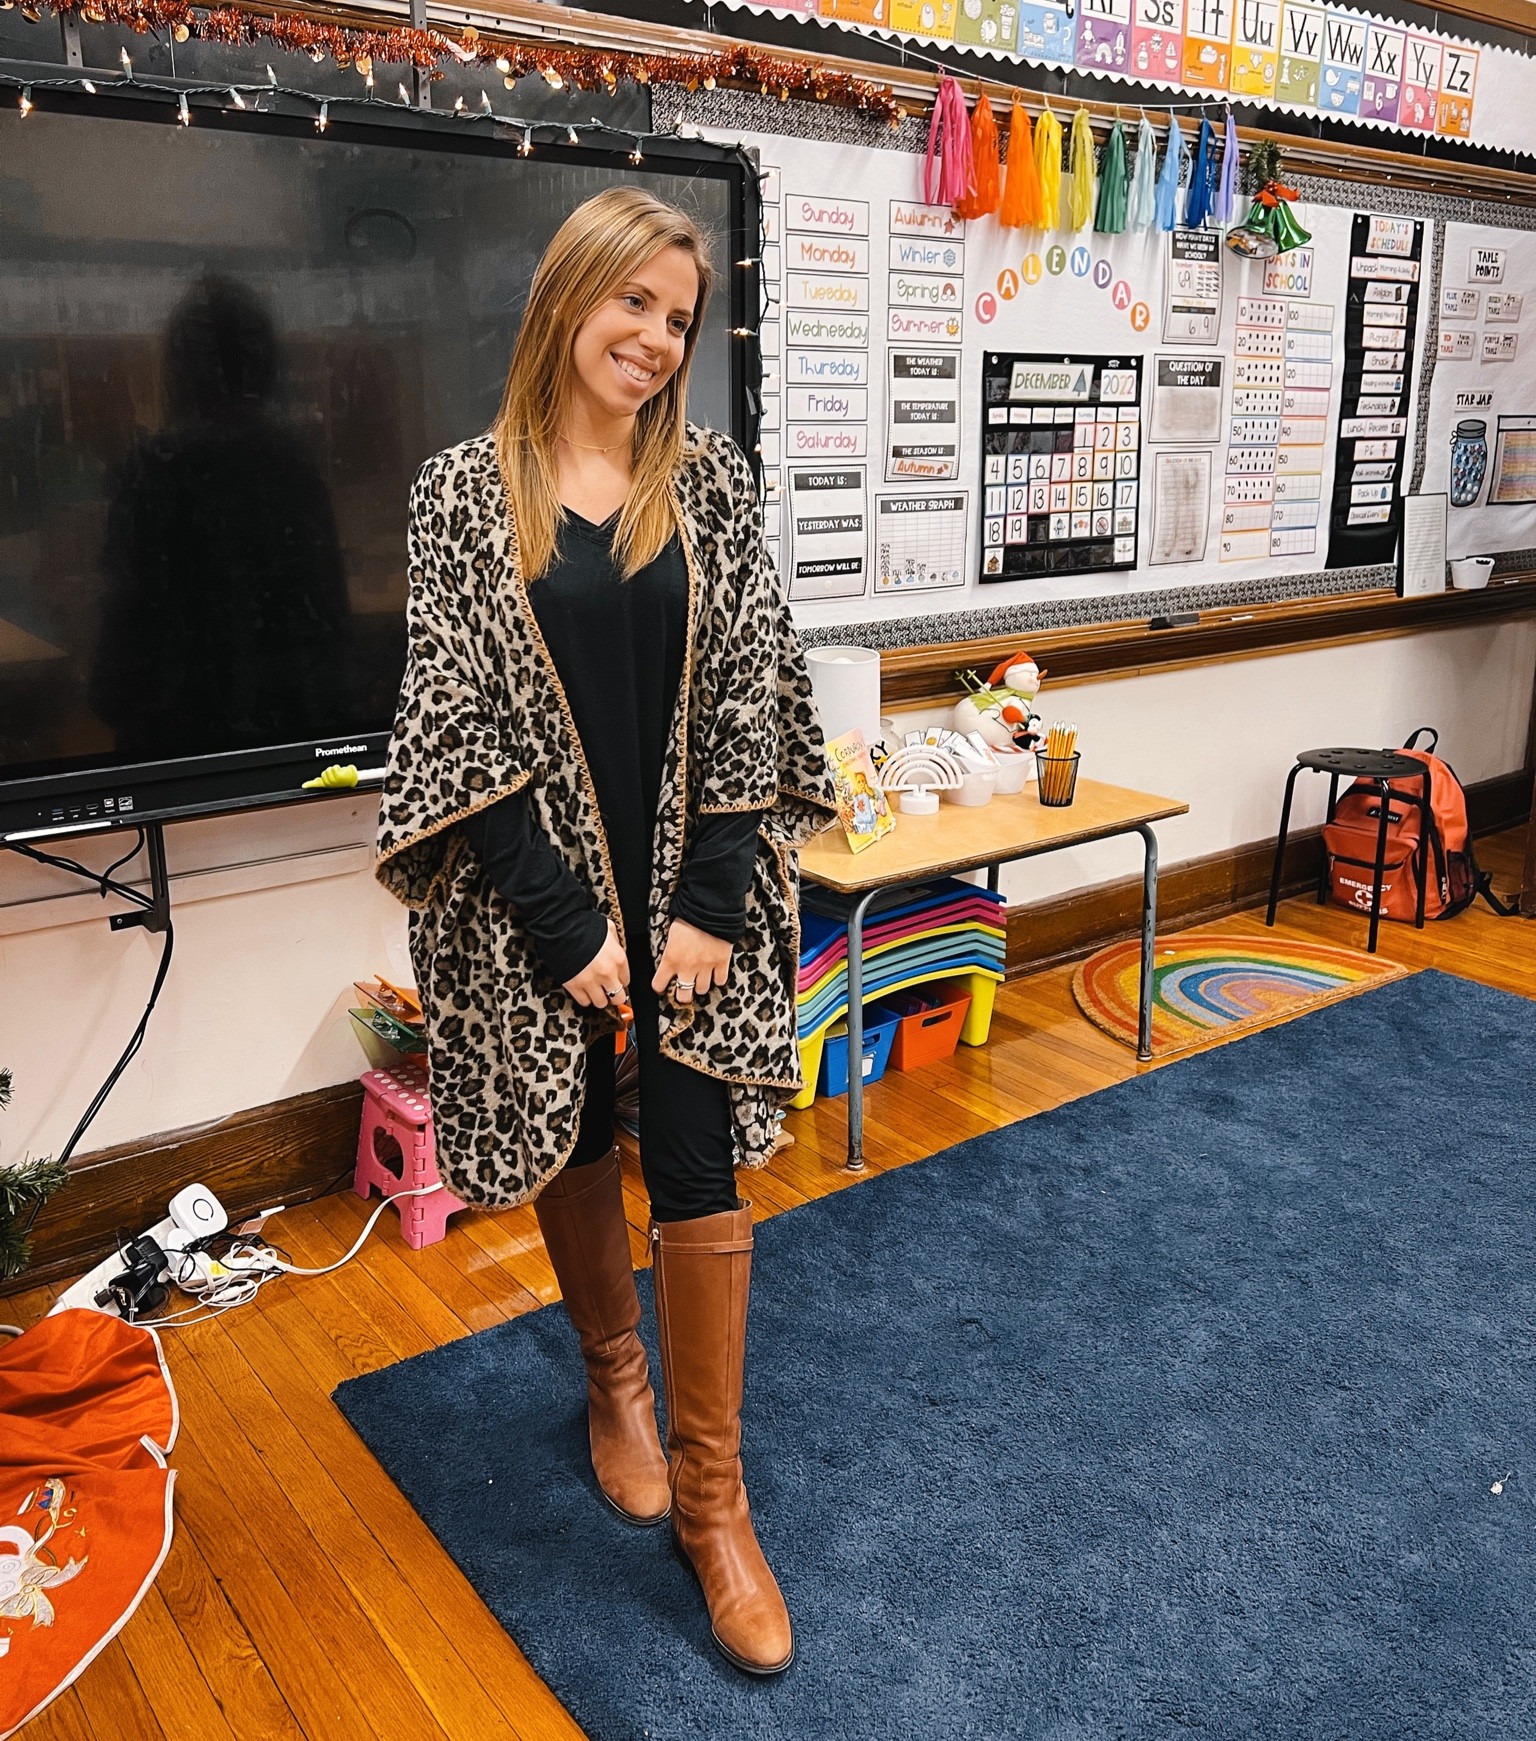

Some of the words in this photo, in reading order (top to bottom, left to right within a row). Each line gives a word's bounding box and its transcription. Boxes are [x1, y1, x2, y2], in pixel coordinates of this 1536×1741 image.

[1243, 0, 1273, 46] Uu
[1290, 10, 1318, 55] Vv
[1327, 20, 1364, 66] Ww
[1371, 31, 1398, 76] Xx
[1412, 42, 1435, 93] Yy
[1446, 53, 1471, 93] Zz
[802, 202, 855, 231] Sunday
[894, 206, 943, 229] Autumn
[1375, 220, 1410, 235] TODAY'S
[1370, 236, 1410, 252] SCHEDULE
[801, 242, 856, 269] Monday
[899, 244, 941, 264] Winter
[1299, 254, 1310, 267] IN
[1178, 270, 1191, 288] 69
[1475, 265, 1500, 278] POINTS
[977, 246, 1148, 330] CALENDAR
[1266, 273, 1309, 291] SCHOOL
[802, 280, 857, 307] Tuesday
[897, 279, 940, 303] Spring
[789, 319, 868, 344] Wednesday
[891, 314, 945, 333] Summer
[1238, 336, 1247, 347] 20
[799, 356, 860, 381] Thursday
[906, 357, 916, 365] THE
[917, 358, 943, 366] WEATHER
[1168, 362, 1205, 372] QUESTION
[1205, 362, 1214, 372] OF
[910, 367, 930, 375] TODAY
[1236, 366, 1245, 377] 30
[1014, 372, 1071, 390] DECEMBER
[1102, 374, 1135, 395] 2022
[1177, 375, 1189, 385] THE
[1190, 375, 1206, 386] DAY
[808, 395, 849, 417] Friday
[901, 402, 911, 410] THE
[912, 402, 949, 410] TEMPERATURE
[1456, 393, 1475, 406] STAR
[1476, 394, 1493, 406] JAR
[910, 412, 930, 420] TODAY
[1101, 426, 1111, 448] 2
[1122, 426, 1132, 447] 3
[1232, 426, 1242, 437] 50
[796, 430, 858, 453] Saturday
[902, 447, 912, 456] THE
[913, 447, 937, 456] SEASON
[1229, 455, 1238, 465] 60
[897, 460, 935, 475] Autumn
[991, 459, 1000, 480] 4
[1012, 458, 1023, 480] 5
[1035, 458, 1046, 479] 6
[1057, 457, 1067, 478] 7
[1077, 457, 1088, 477] 8
[1100, 455, 1109, 476] 9
[1119, 455, 1133, 475] 10
[808, 476, 835, 486] TODAY
[837, 475, 848, 486] IS:
[989, 490, 1002, 511] 11
[1012, 489, 1024, 510] 12
[1033, 488, 1045, 510] 13
[1055, 487, 1067, 508] 14
[1075, 486, 1088, 507] 15
[1096, 485, 1109, 506] 16
[1120, 485, 1133, 505] 17
[1226, 485, 1236, 496] 70
[890, 501, 926, 512] WEATHER
[928, 500, 955, 510] GRAPH
[798, 519, 840, 531] YESTERDAY
[841, 518, 862, 529] WAS:
[1225, 514, 1234, 524] 80
[989, 521, 1001, 543] 18
[1010, 517, 1023, 539] 19
[798, 564, 835, 575] TOMORROW
[836, 563, 849, 572] WILL
[315, 744, 368, 758] Promethean
[1339, 877, 1393, 893] EMERGECY
